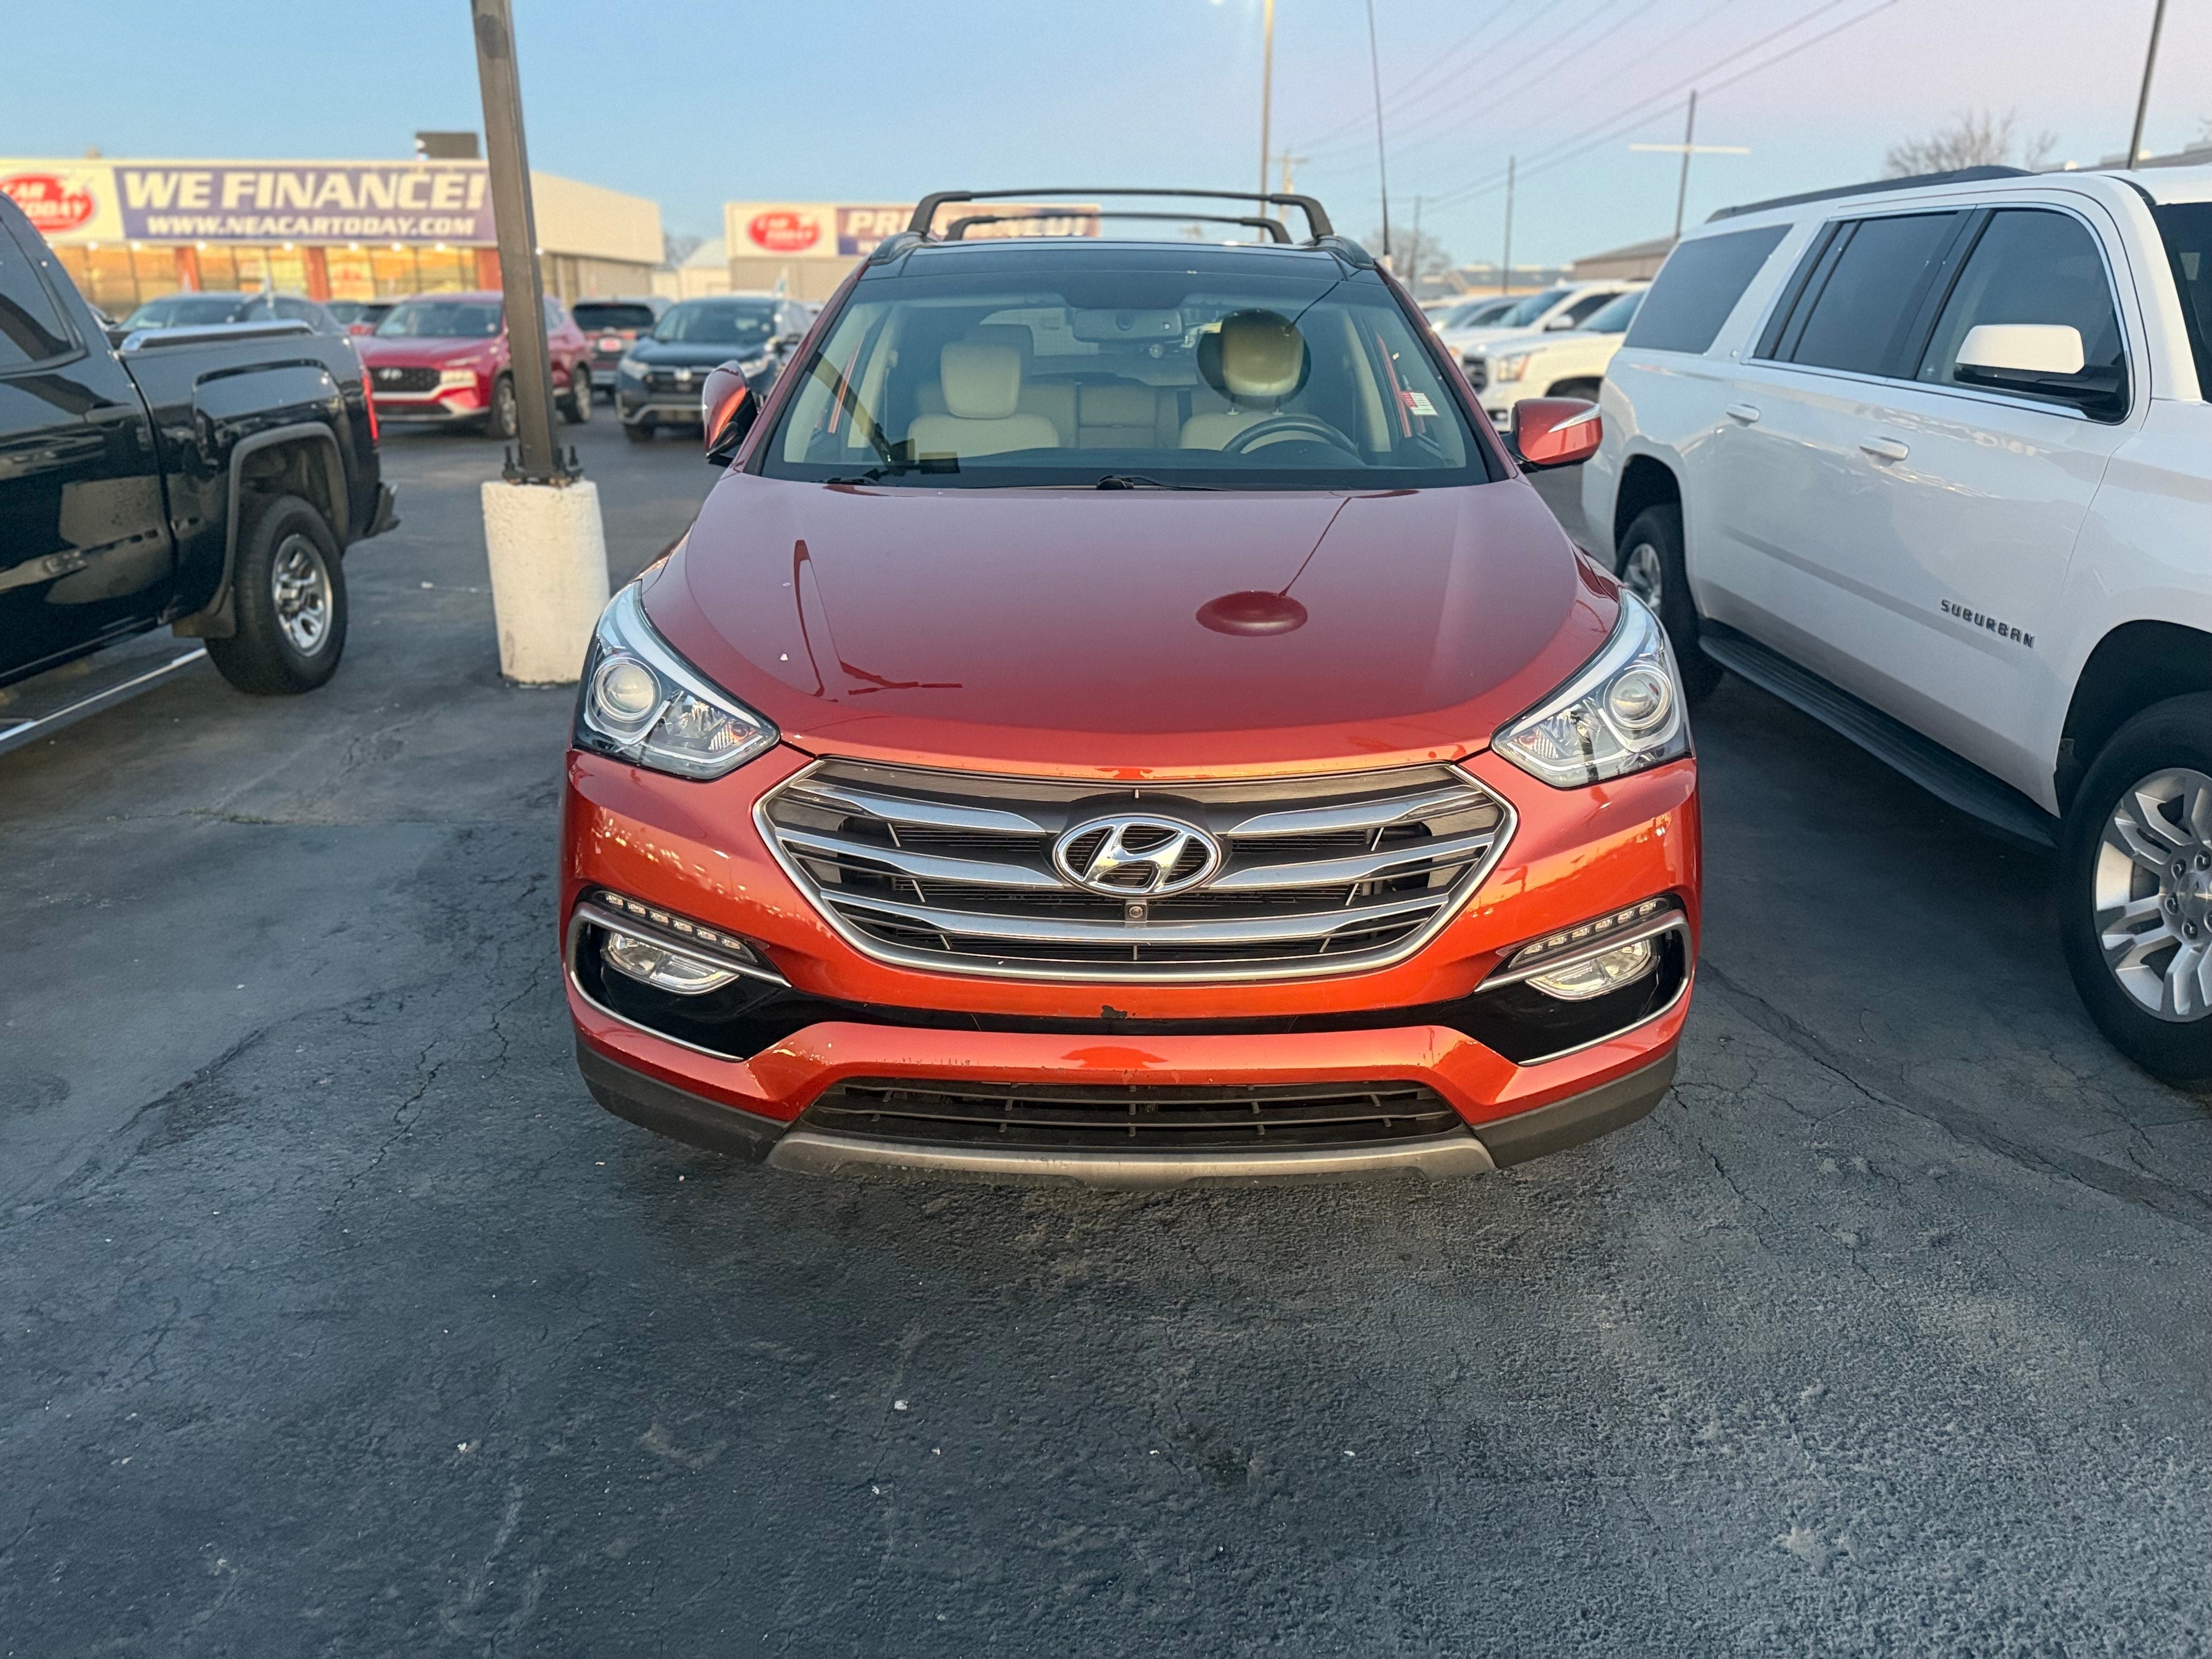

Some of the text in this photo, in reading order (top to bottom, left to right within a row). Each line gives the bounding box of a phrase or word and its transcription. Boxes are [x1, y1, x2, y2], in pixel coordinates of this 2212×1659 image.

[123, 172, 487, 210] WE FINANCE!
[1940, 599, 2035, 648] SUBURBAN
